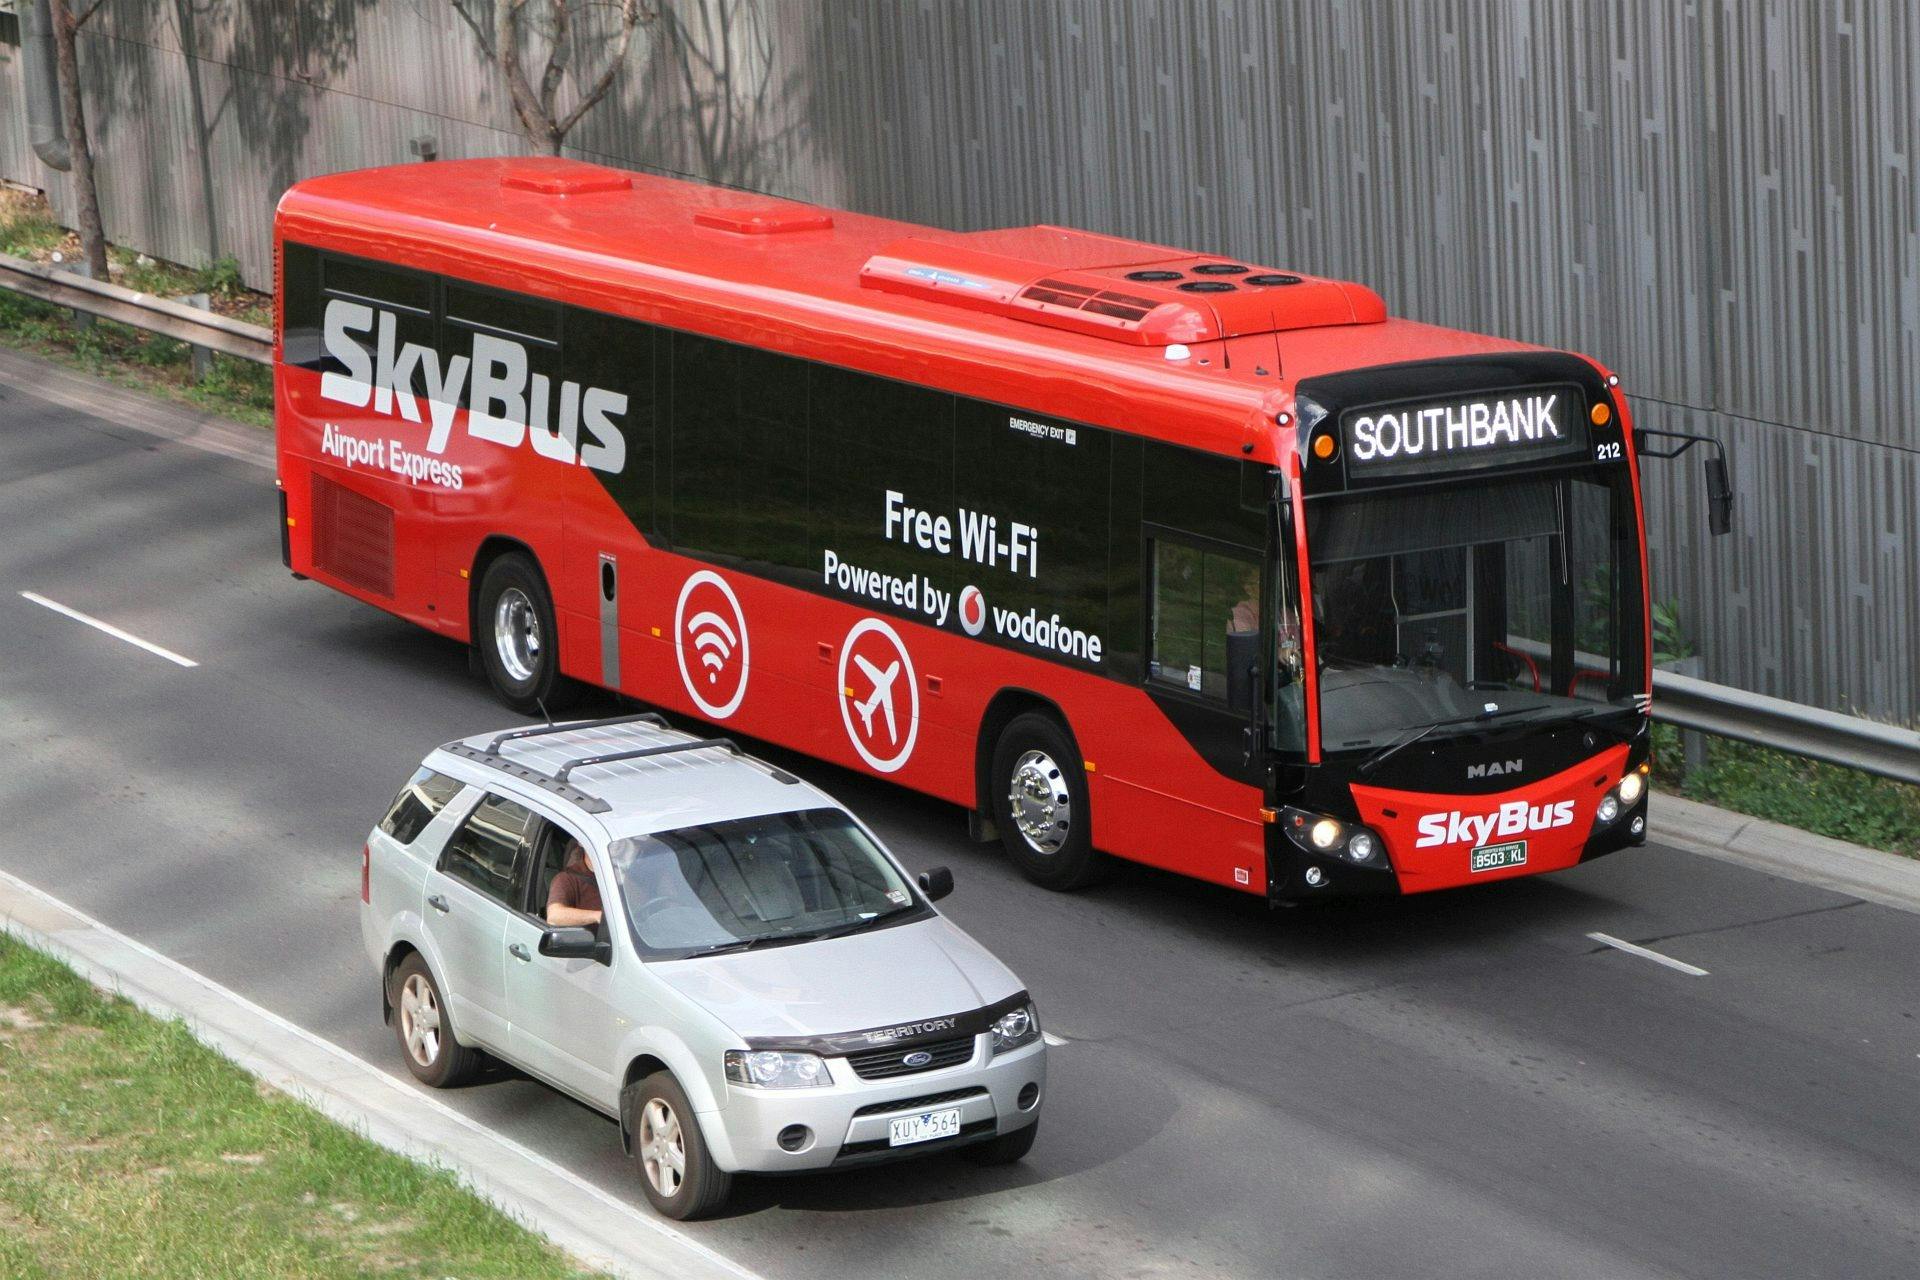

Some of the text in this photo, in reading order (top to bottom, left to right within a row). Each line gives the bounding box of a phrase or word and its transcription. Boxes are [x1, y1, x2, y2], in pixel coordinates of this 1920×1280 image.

[321, 299, 628, 475] SkyBus
[1009, 417, 1065, 440] EMERGENCY EXIT
[1354, 394, 1558, 460] SOUTHBANK
[321, 422, 463, 490] Airport Express
[1597, 442, 1621, 460] 212
[885, 489, 1038, 578] Free Wi-Fi
[824, 549, 1102, 663] Powered by vodafone
[1467, 759, 1523, 779] MAN
[1415, 800, 1575, 848] SkyBus
[1510, 849, 1525, 862] KL
[862, 1018, 956, 1042] TERRITORY
[893, 1120, 921, 1140] XUY
[931, 1112, 957, 1133] 564
